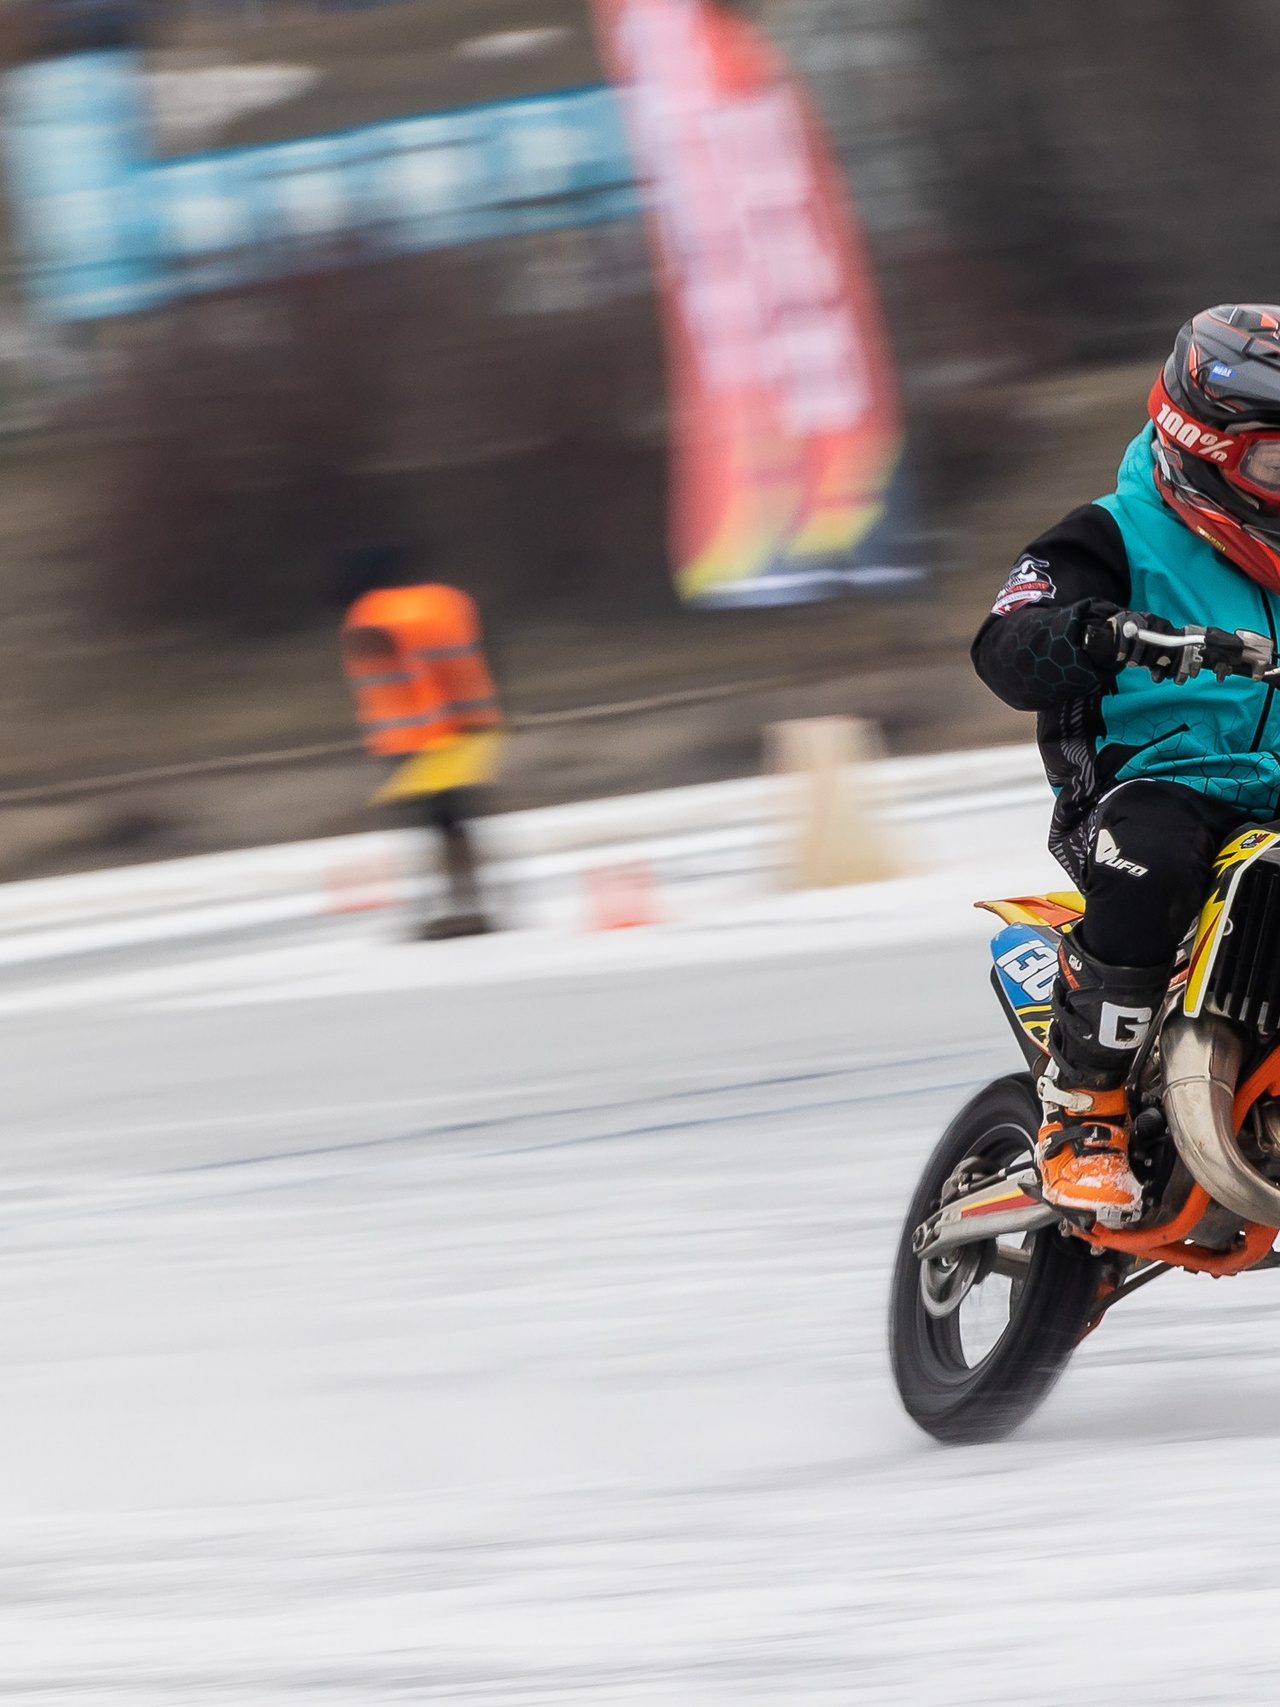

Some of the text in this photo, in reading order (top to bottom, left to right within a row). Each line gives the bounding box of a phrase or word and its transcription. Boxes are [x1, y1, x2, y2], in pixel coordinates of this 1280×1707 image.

[1156, 403, 1236, 463] 100%
[1105, 854, 1149, 878] UFO
[995, 939, 1059, 1002] 130
